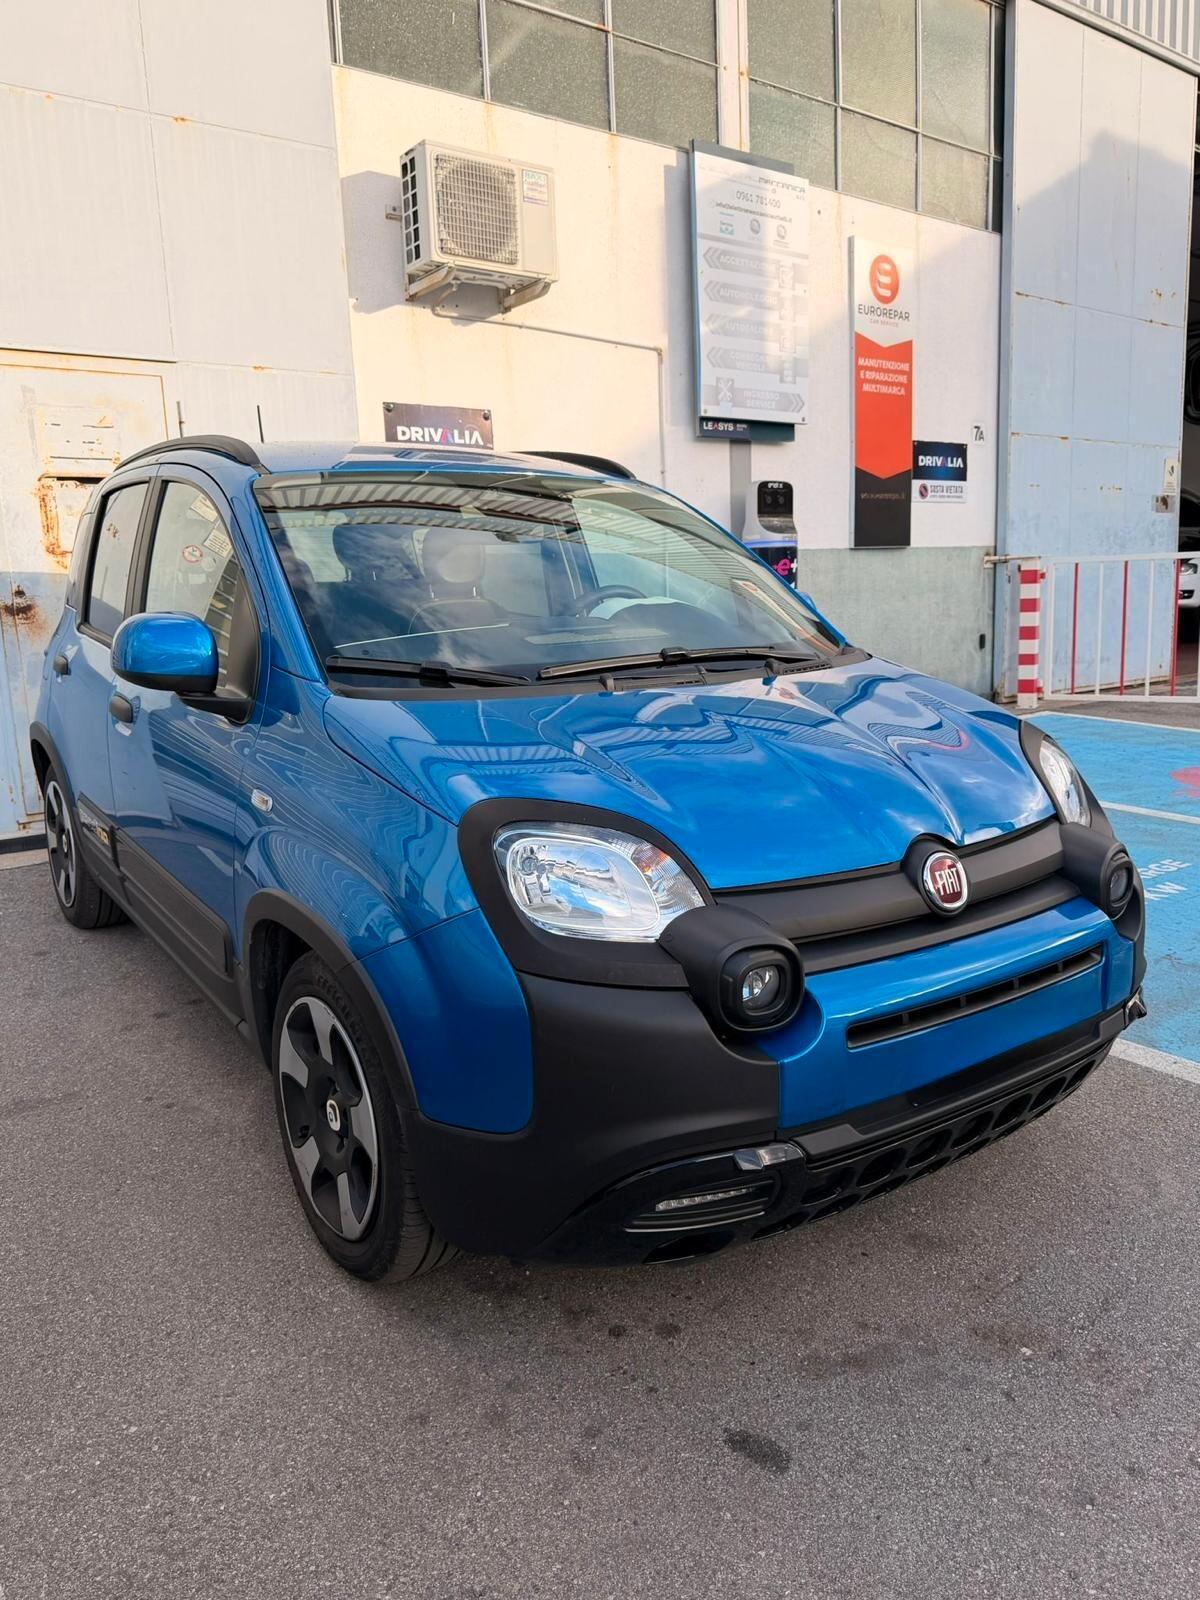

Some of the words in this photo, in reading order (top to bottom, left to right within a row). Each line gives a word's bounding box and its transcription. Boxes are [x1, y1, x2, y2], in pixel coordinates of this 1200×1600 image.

[857, 303, 911, 322] EUROREPAR
[857, 356, 911, 372] MANUTENZIONE
[859, 370, 865, 379] E
[865, 370, 909, 384] RIPARAZIONE
[862, 382, 906, 396] MULTIMARCA
[703, 421, 734, 432] LEASYS
[396, 425, 484, 446] DRIVALIA
[918, 455, 964, 468] DRIVALIA
[934, 867, 961, 896] FIAT
